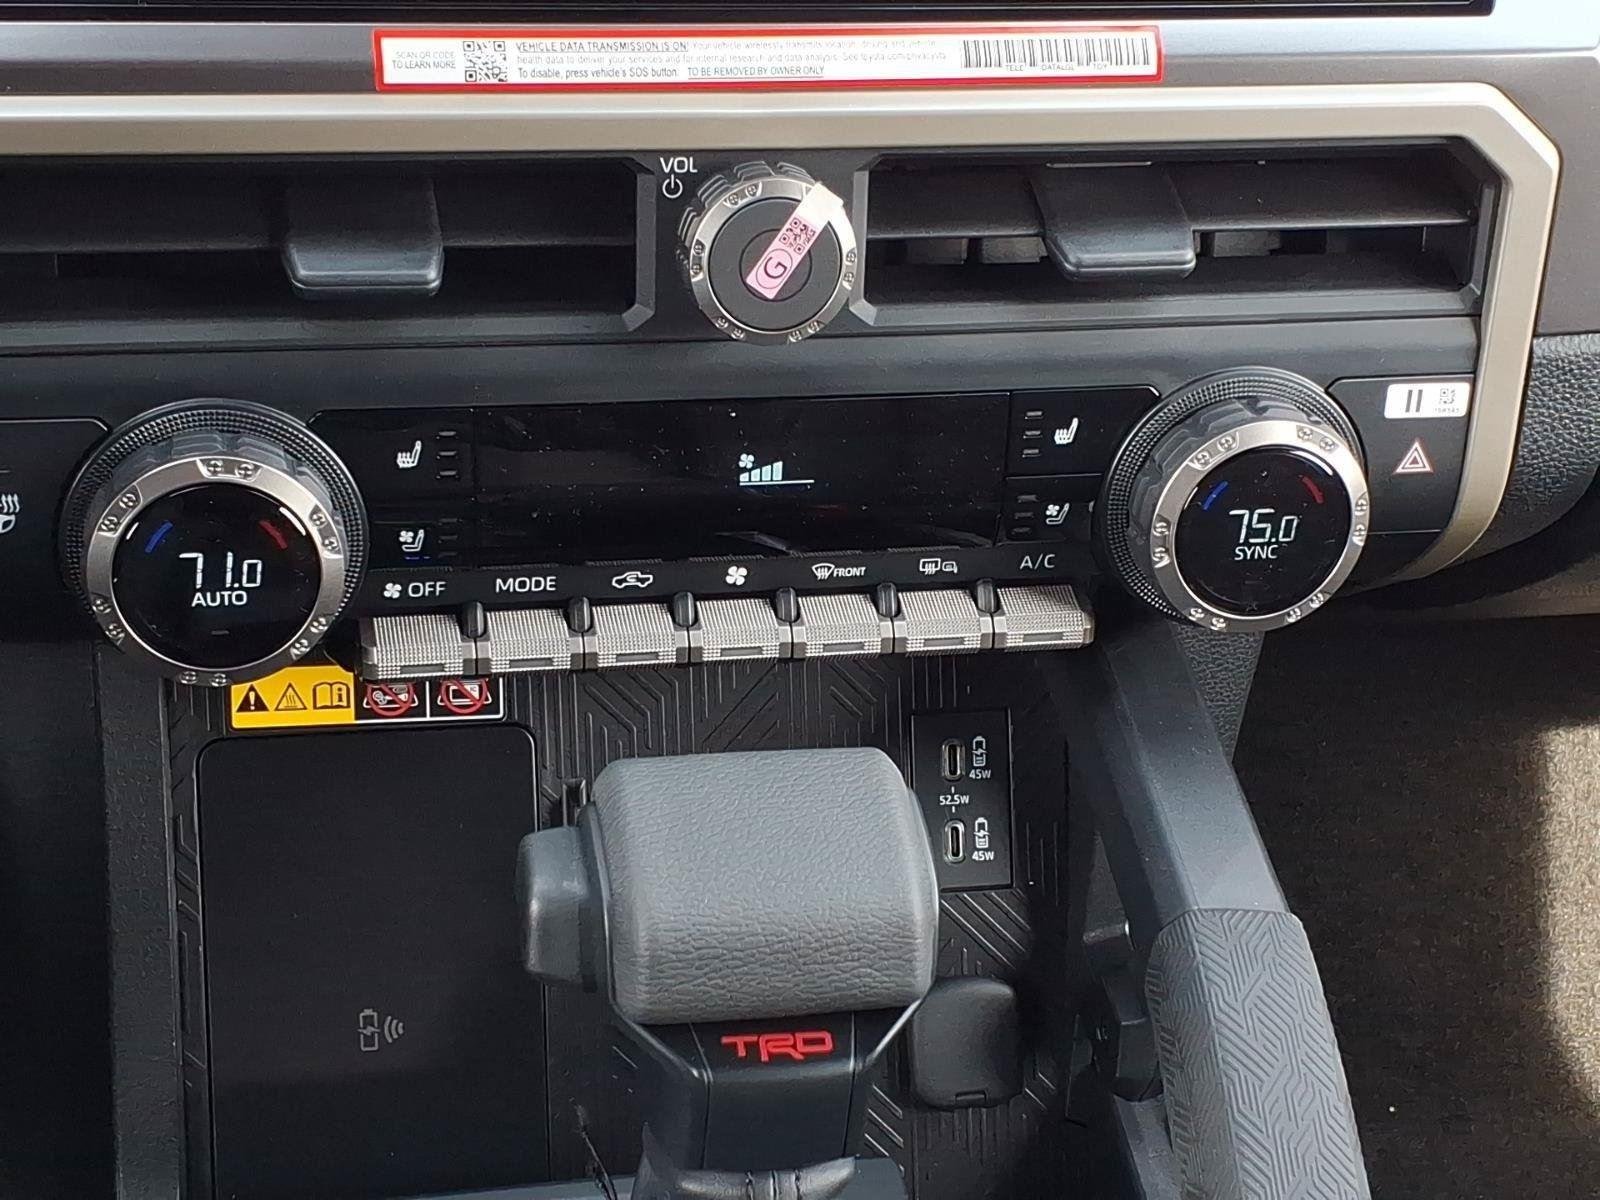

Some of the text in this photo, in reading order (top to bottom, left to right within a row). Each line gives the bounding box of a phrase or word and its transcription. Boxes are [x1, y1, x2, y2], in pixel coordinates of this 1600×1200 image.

[515, 41, 557, 51] VEHICLE
[559, 41, 584, 51] DATA
[587, 41, 659, 51] TRANSMISSION
[661, 41, 670, 50] IS
[395, 51, 418, 59] SCAN
[432, 51, 456, 59] CODE
[517, 54, 543, 64] health
[545, 54, 565, 64] data
[567, 55, 575, 64] to
[577, 54, 605, 64] deliver
[608, 55, 626, 66] your
[629, 54, 662, 64] services
[665, 54, 681, 64] and
[391, 60, 456, 69] TO LEARN MORE
[518, 67, 528, 78] To
[530, 67, 563, 80] disable,
[565, 69, 589, 80] press
[591, 67, 627, 78] vehicle's
[629, 67, 649, 78] SOS
[687, 67, 699, 76] TO
[701, 67, 712, 76] BE
[714, 67, 755, 76] REMOVED
[757, 67, 768, 76] BY
[770, 66, 802, 76] OWNER
[803, 65, 825, 75] ONLY
[660, 157, 698, 173] VOL
[763, 256, 788, 279] G
[1228, 508, 1298, 543] 75.0
[1234, 544, 1279, 560] SYNC
[1019, 553, 1056, 570] A/C
[179, 551, 263, 589] 71.0
[833, 566, 866, 577] FRONT
[407, 581, 447, 597] OFF
[495, 576, 557, 593] MODE
[191, 590, 248, 607] AUTO
[969, 769, 992, 779] 45W
[939, 795, 970, 805] 52.5W
[971, 850, 995, 861] 45W
[721, 1030, 833, 1062] TRD
